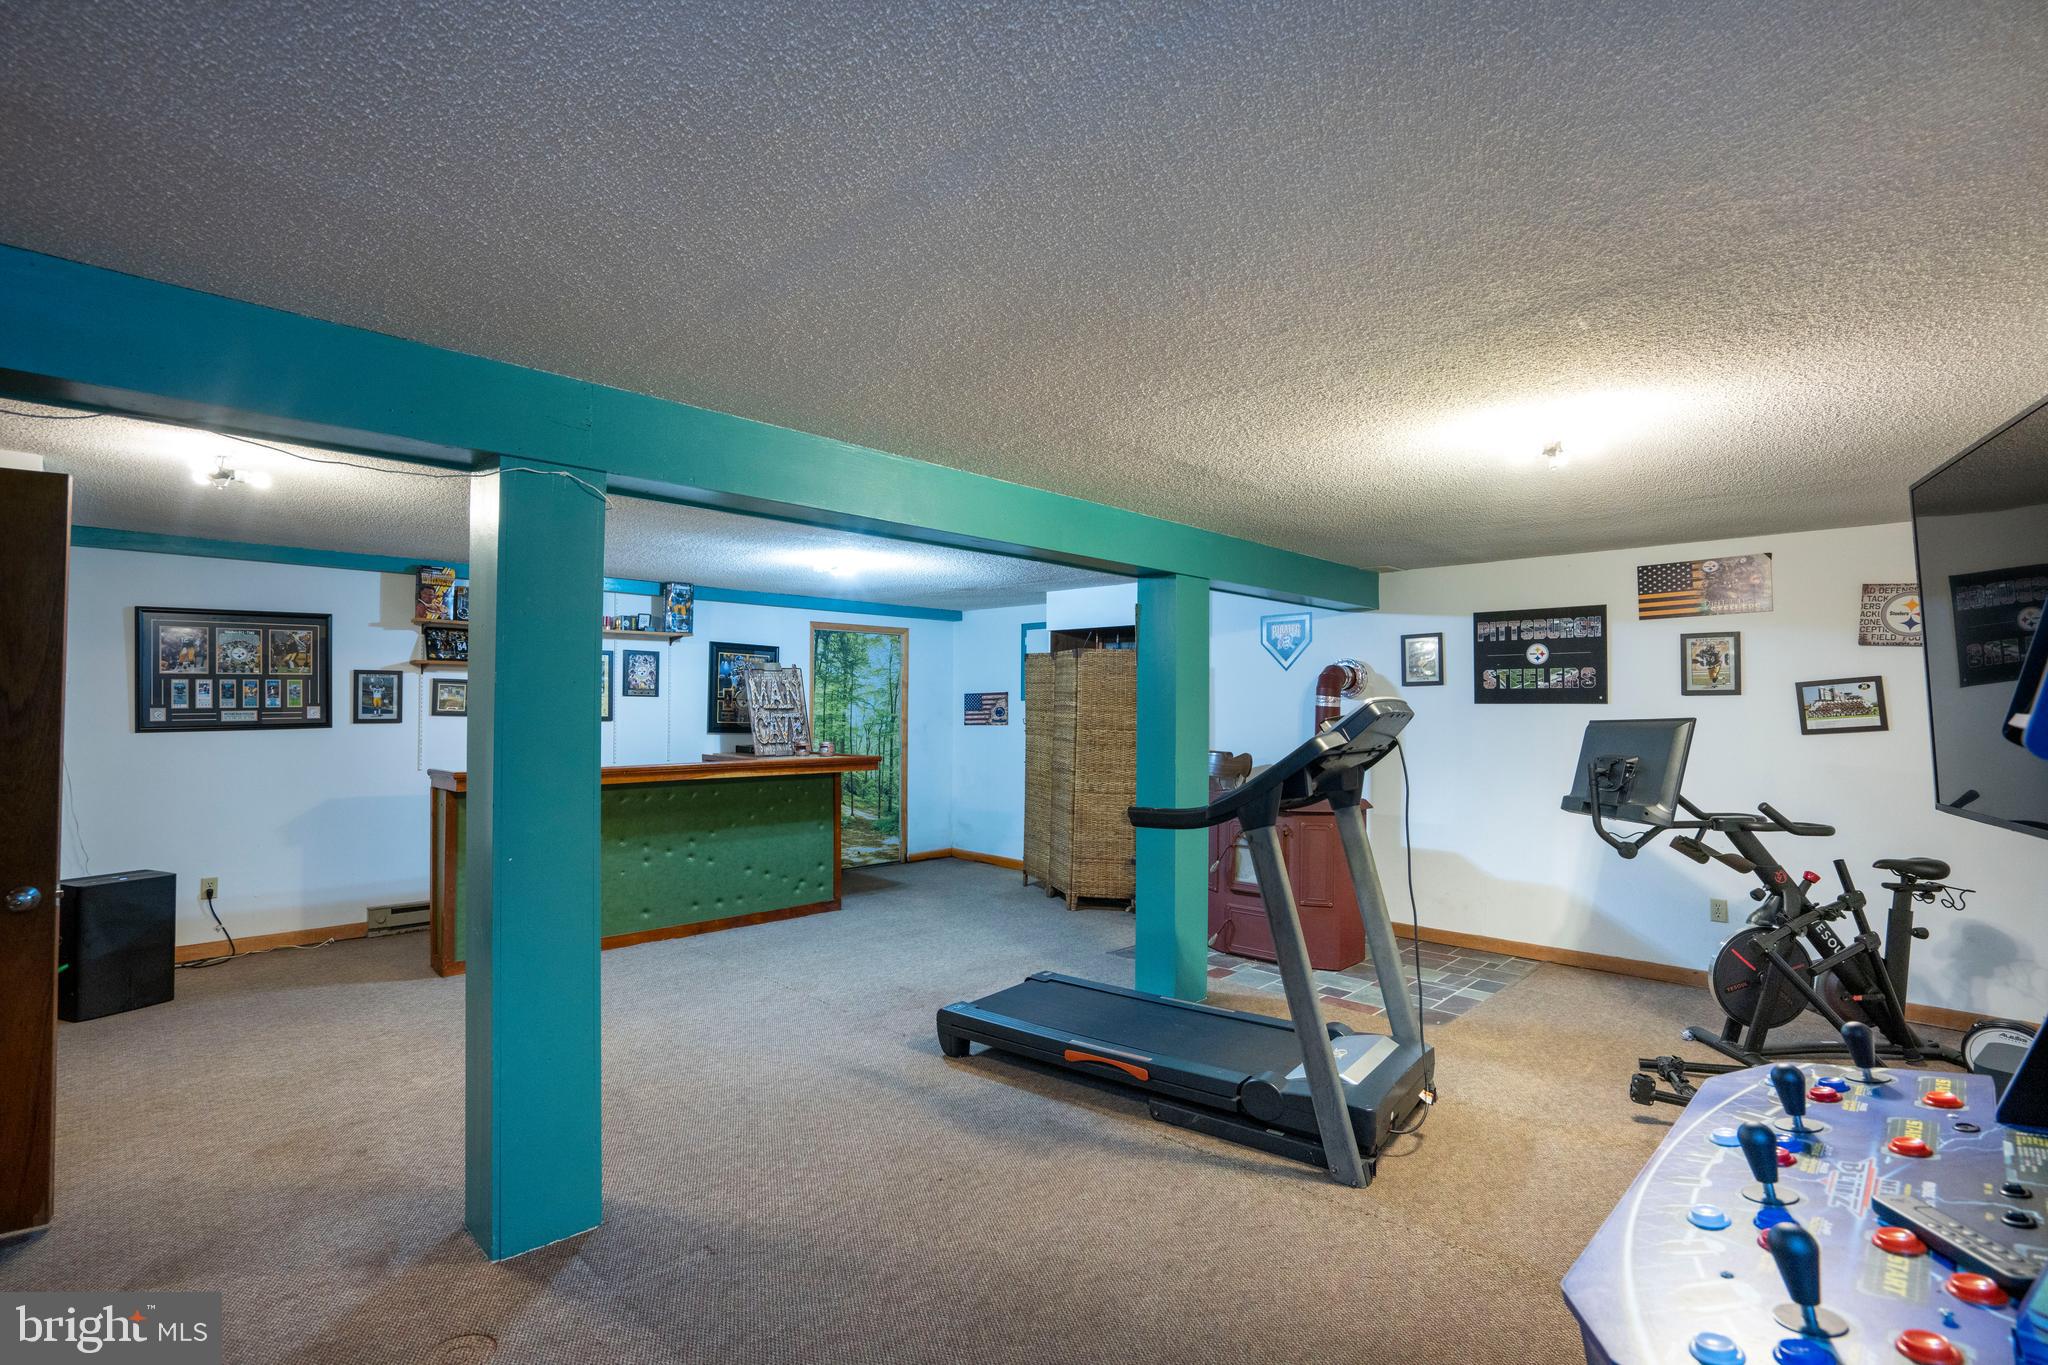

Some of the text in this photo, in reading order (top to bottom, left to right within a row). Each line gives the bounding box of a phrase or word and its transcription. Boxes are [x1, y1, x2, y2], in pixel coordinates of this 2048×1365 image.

[1477, 616, 1602, 642] PITTSBURGH
[457, 642, 468, 651] 84
[1483, 667, 1597, 689] STEELERS
[749, 678, 801, 711] MAN
[755, 712, 807, 744] CAVE
[1883, 1256, 1910, 1296] START
